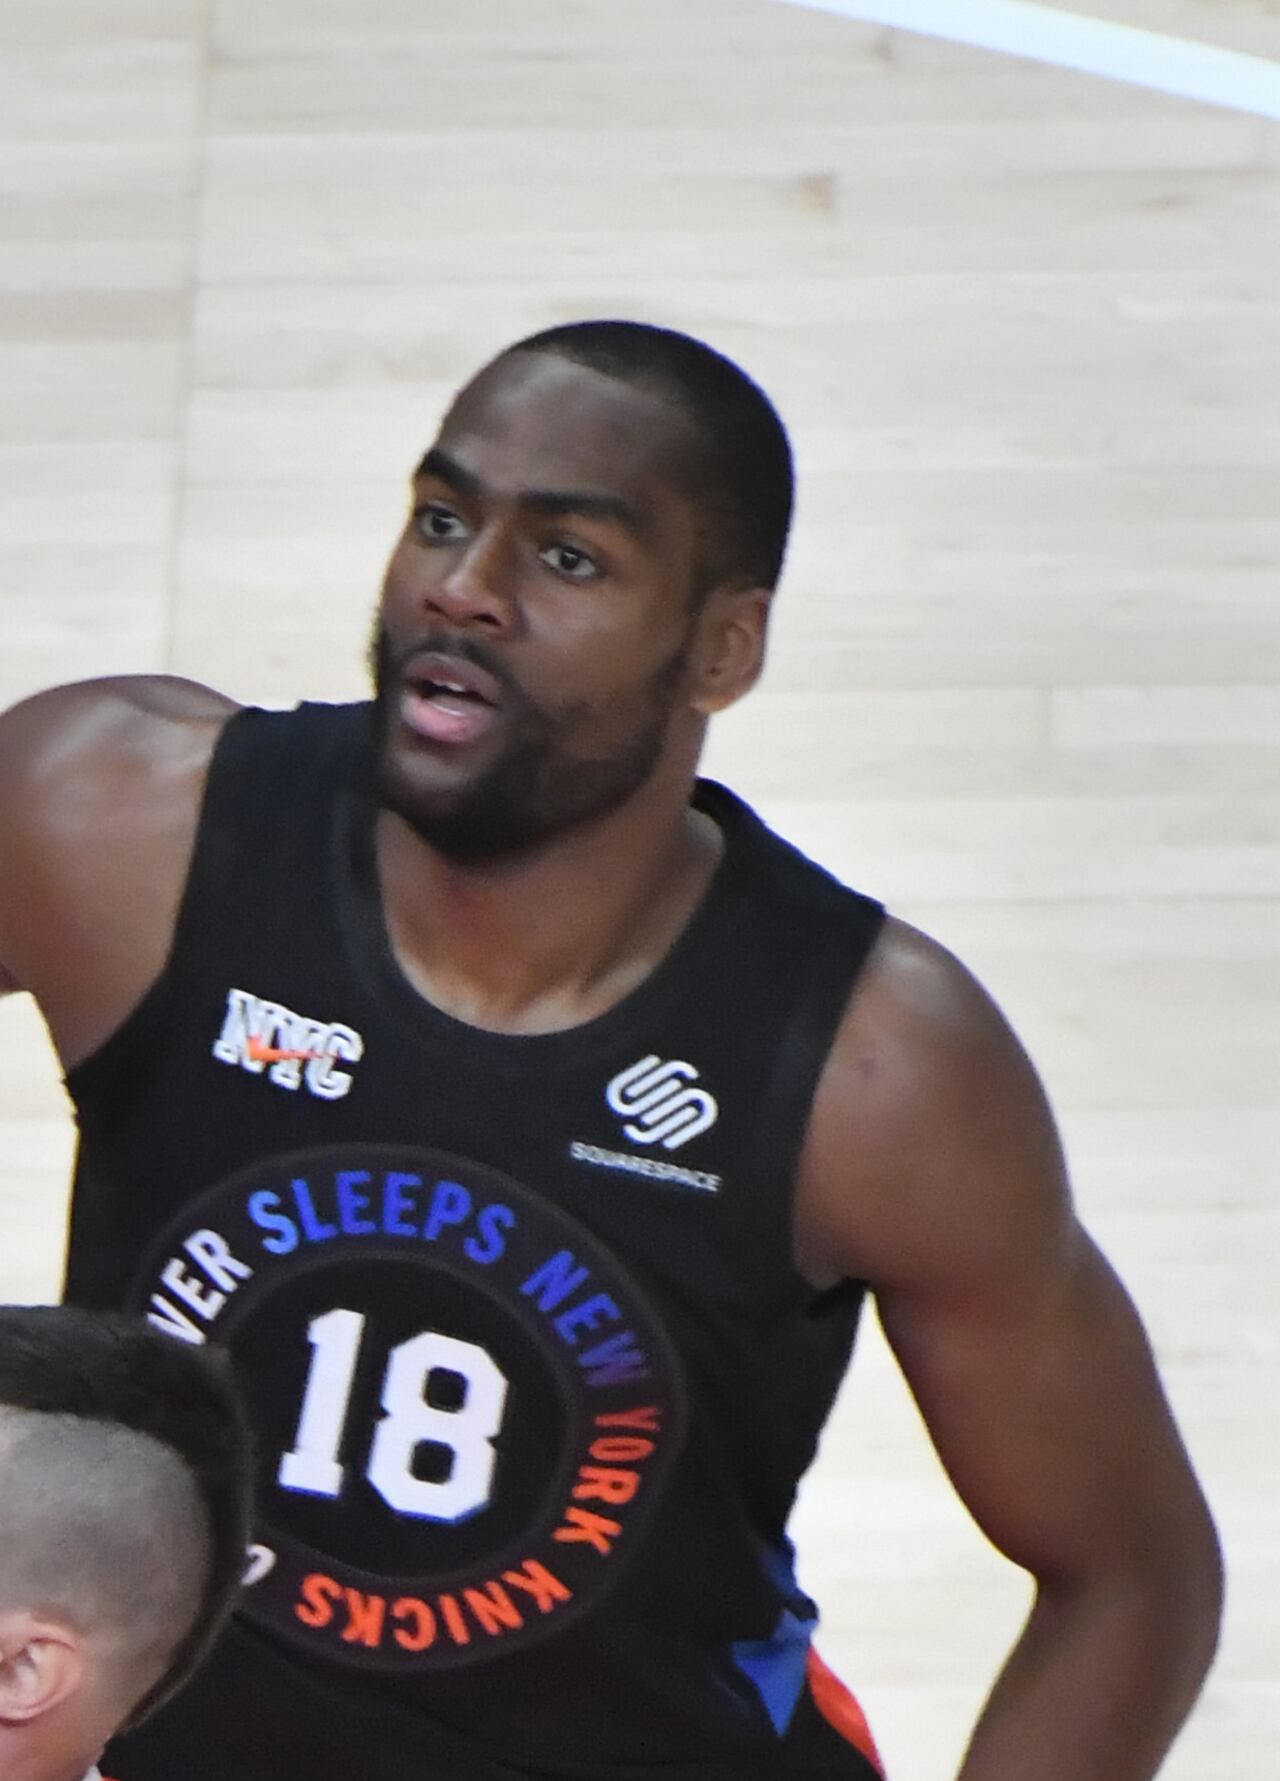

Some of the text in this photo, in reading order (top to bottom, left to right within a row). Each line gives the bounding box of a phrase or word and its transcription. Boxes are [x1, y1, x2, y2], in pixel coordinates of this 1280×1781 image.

[212, 988, 366, 1102] NYC
[570, 1140, 724, 1193] SQUARESPACE
[145, 1171, 664, 1654] VER SLEEPS NEW YORK KNICKS
[276, 1307, 510, 1526] 18
